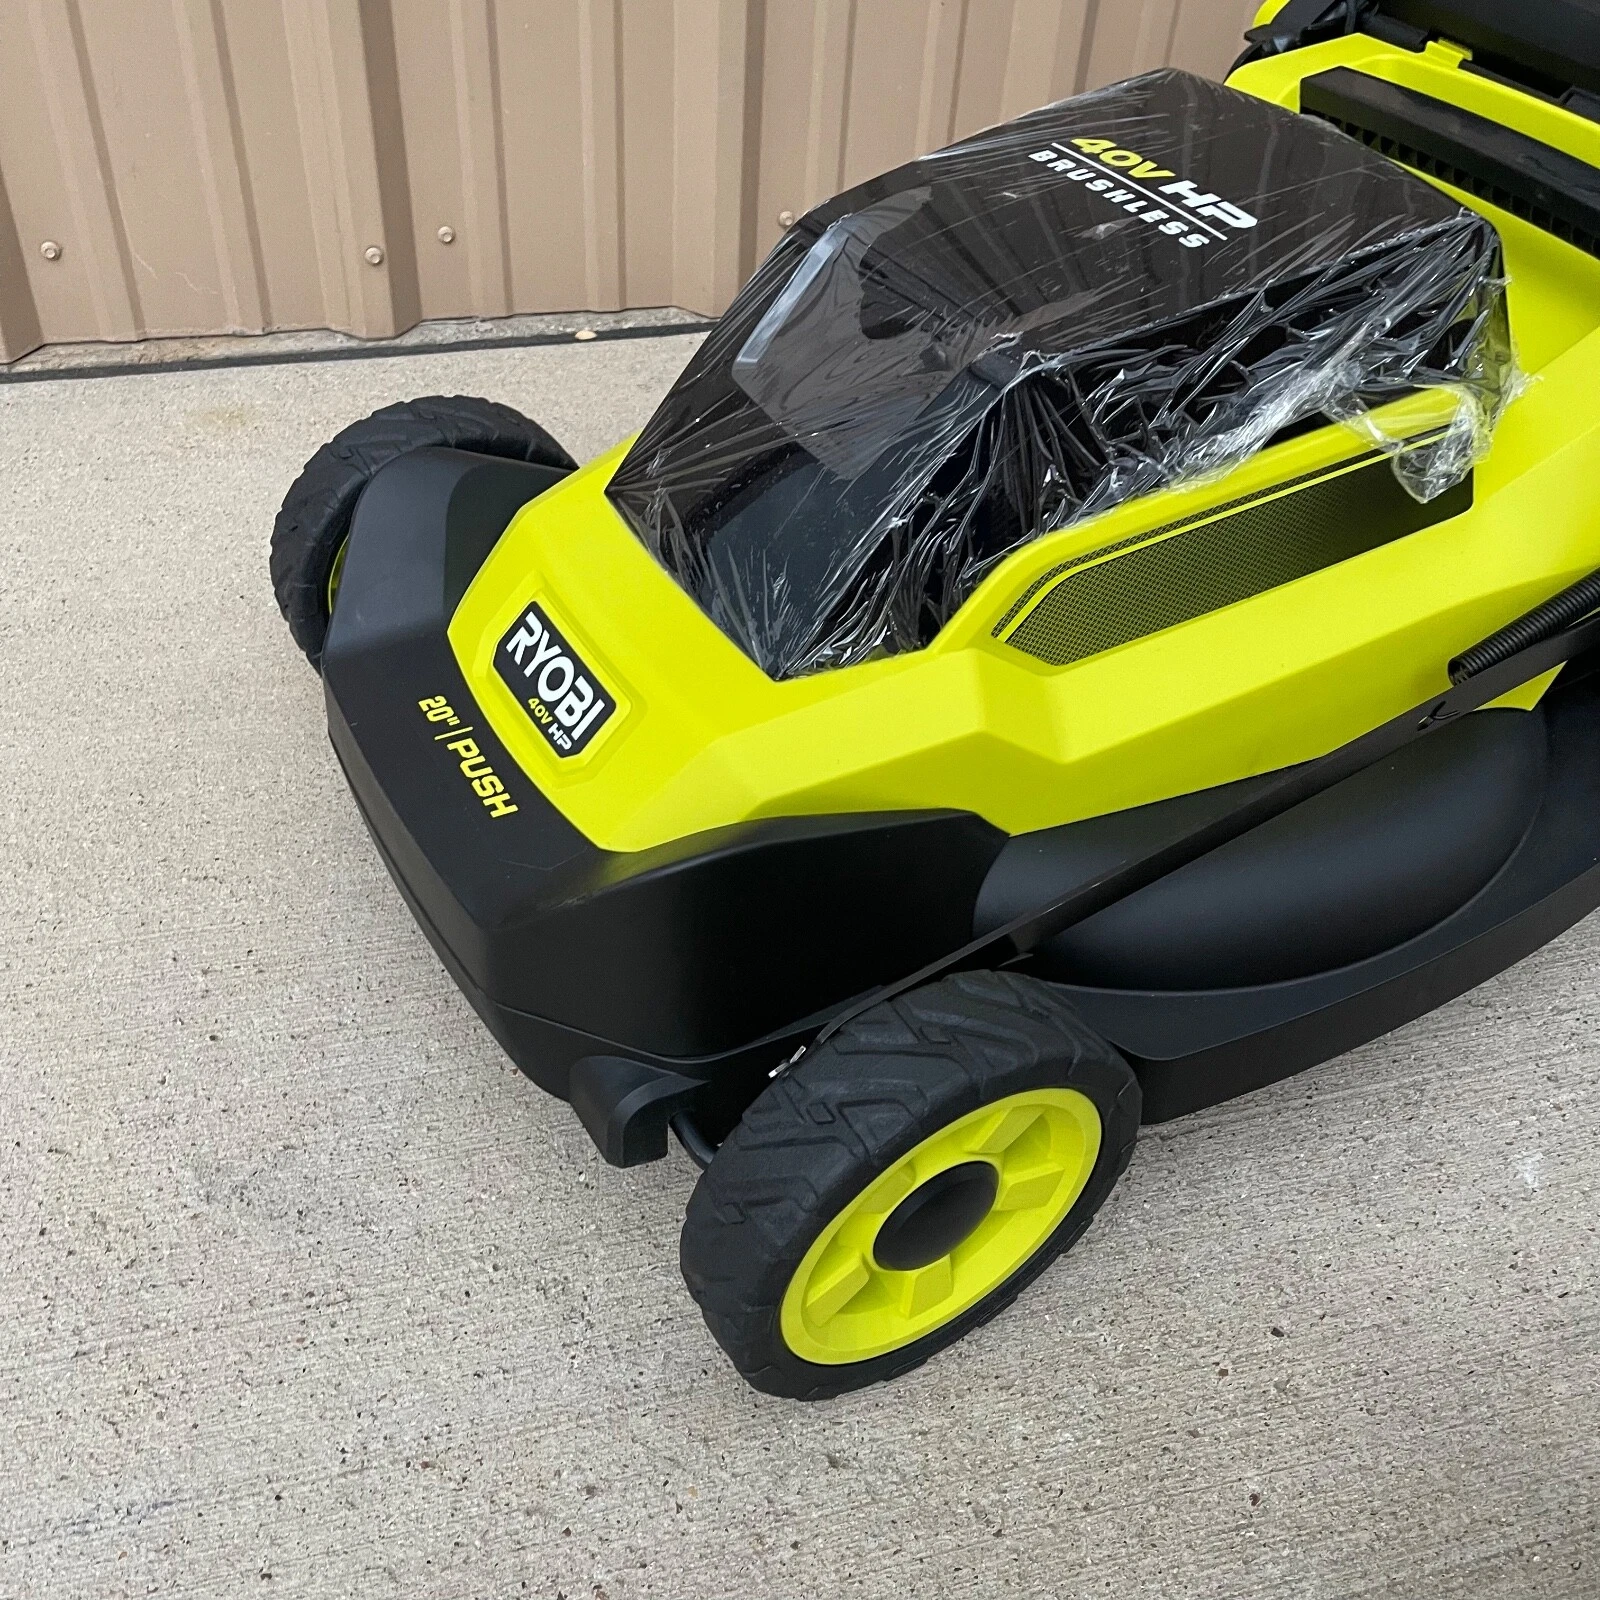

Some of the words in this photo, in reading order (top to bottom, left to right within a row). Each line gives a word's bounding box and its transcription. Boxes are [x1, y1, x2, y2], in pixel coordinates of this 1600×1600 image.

[1028, 149, 1210, 248] BRUSHLESS
[505, 611, 606, 741] RYOBI
[527, 697, 553, 725] 40V
[547, 722, 573, 750] HP
[446, 737, 519, 818] PUSH
